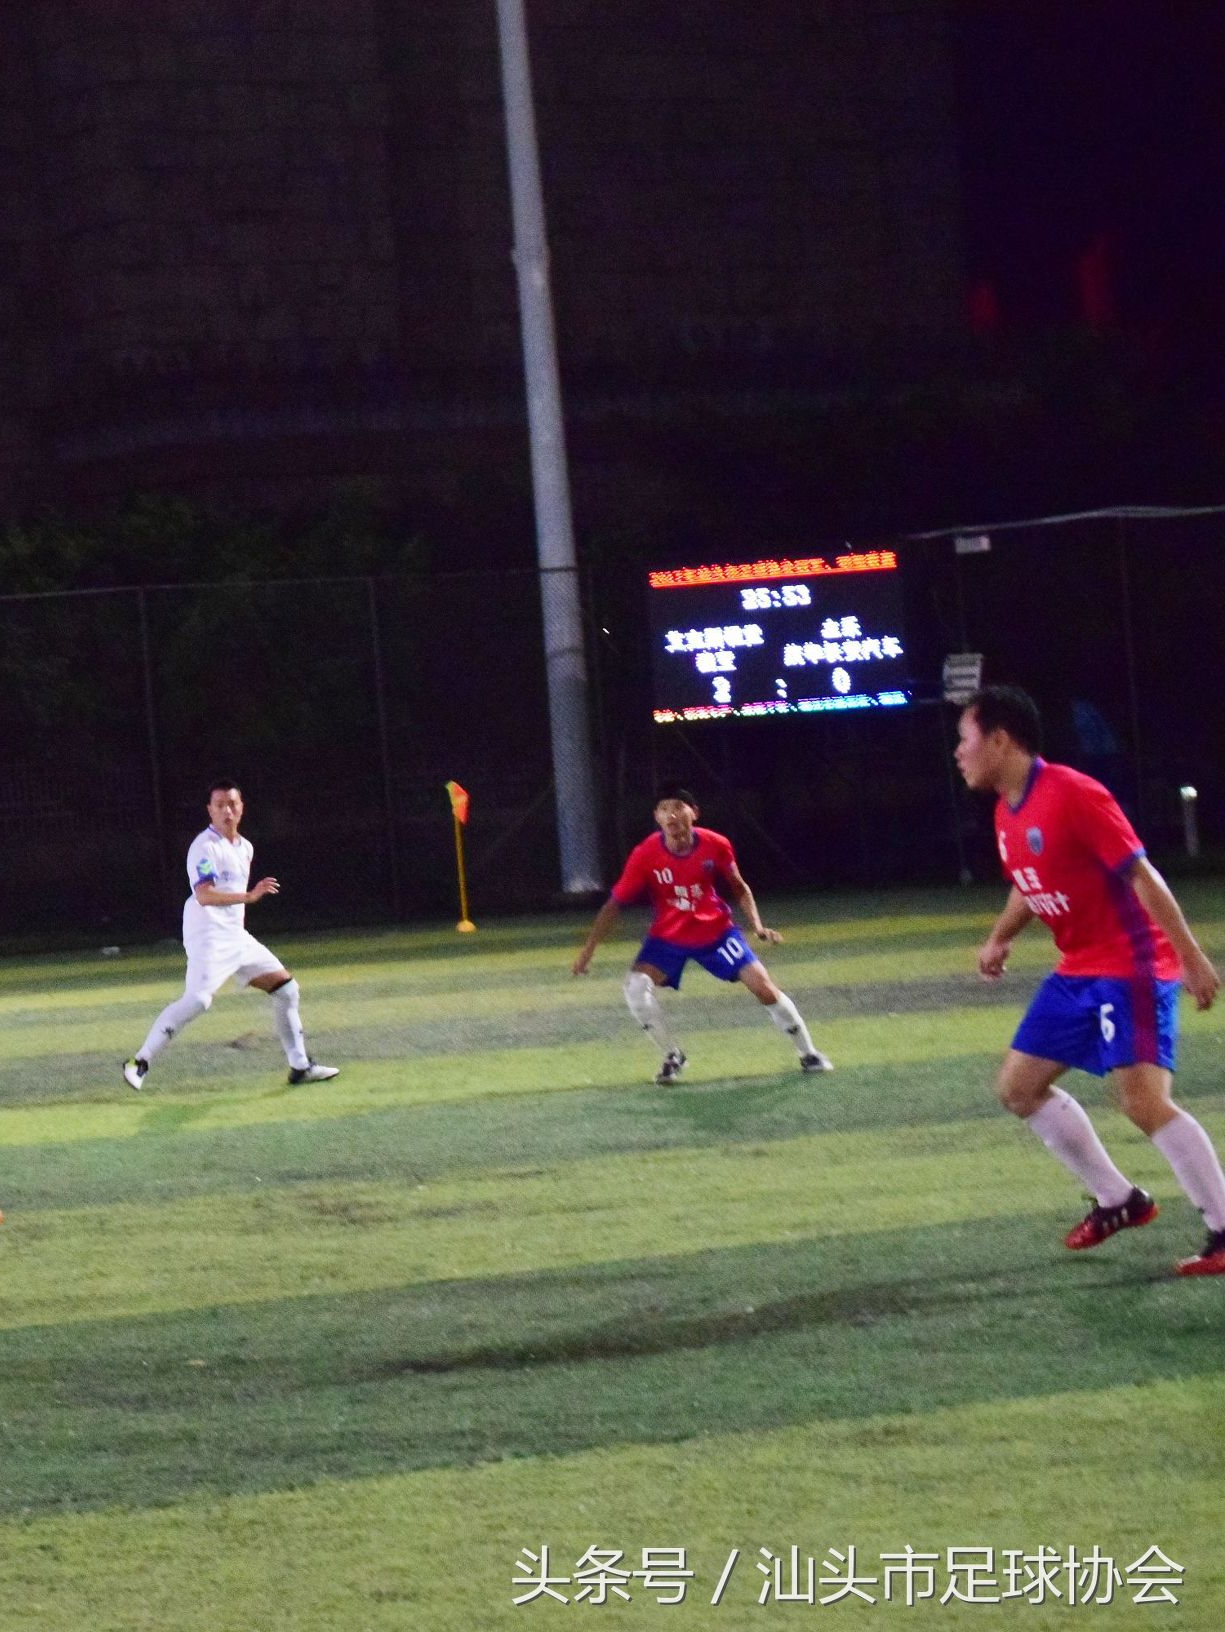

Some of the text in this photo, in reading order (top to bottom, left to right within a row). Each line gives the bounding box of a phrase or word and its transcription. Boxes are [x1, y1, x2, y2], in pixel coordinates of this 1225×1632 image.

[831, 667, 852, 694] 0
[653, 867, 674, 885] 10
[717, 938, 745, 966] 10
[1100, 1002, 1116, 1042] 6
